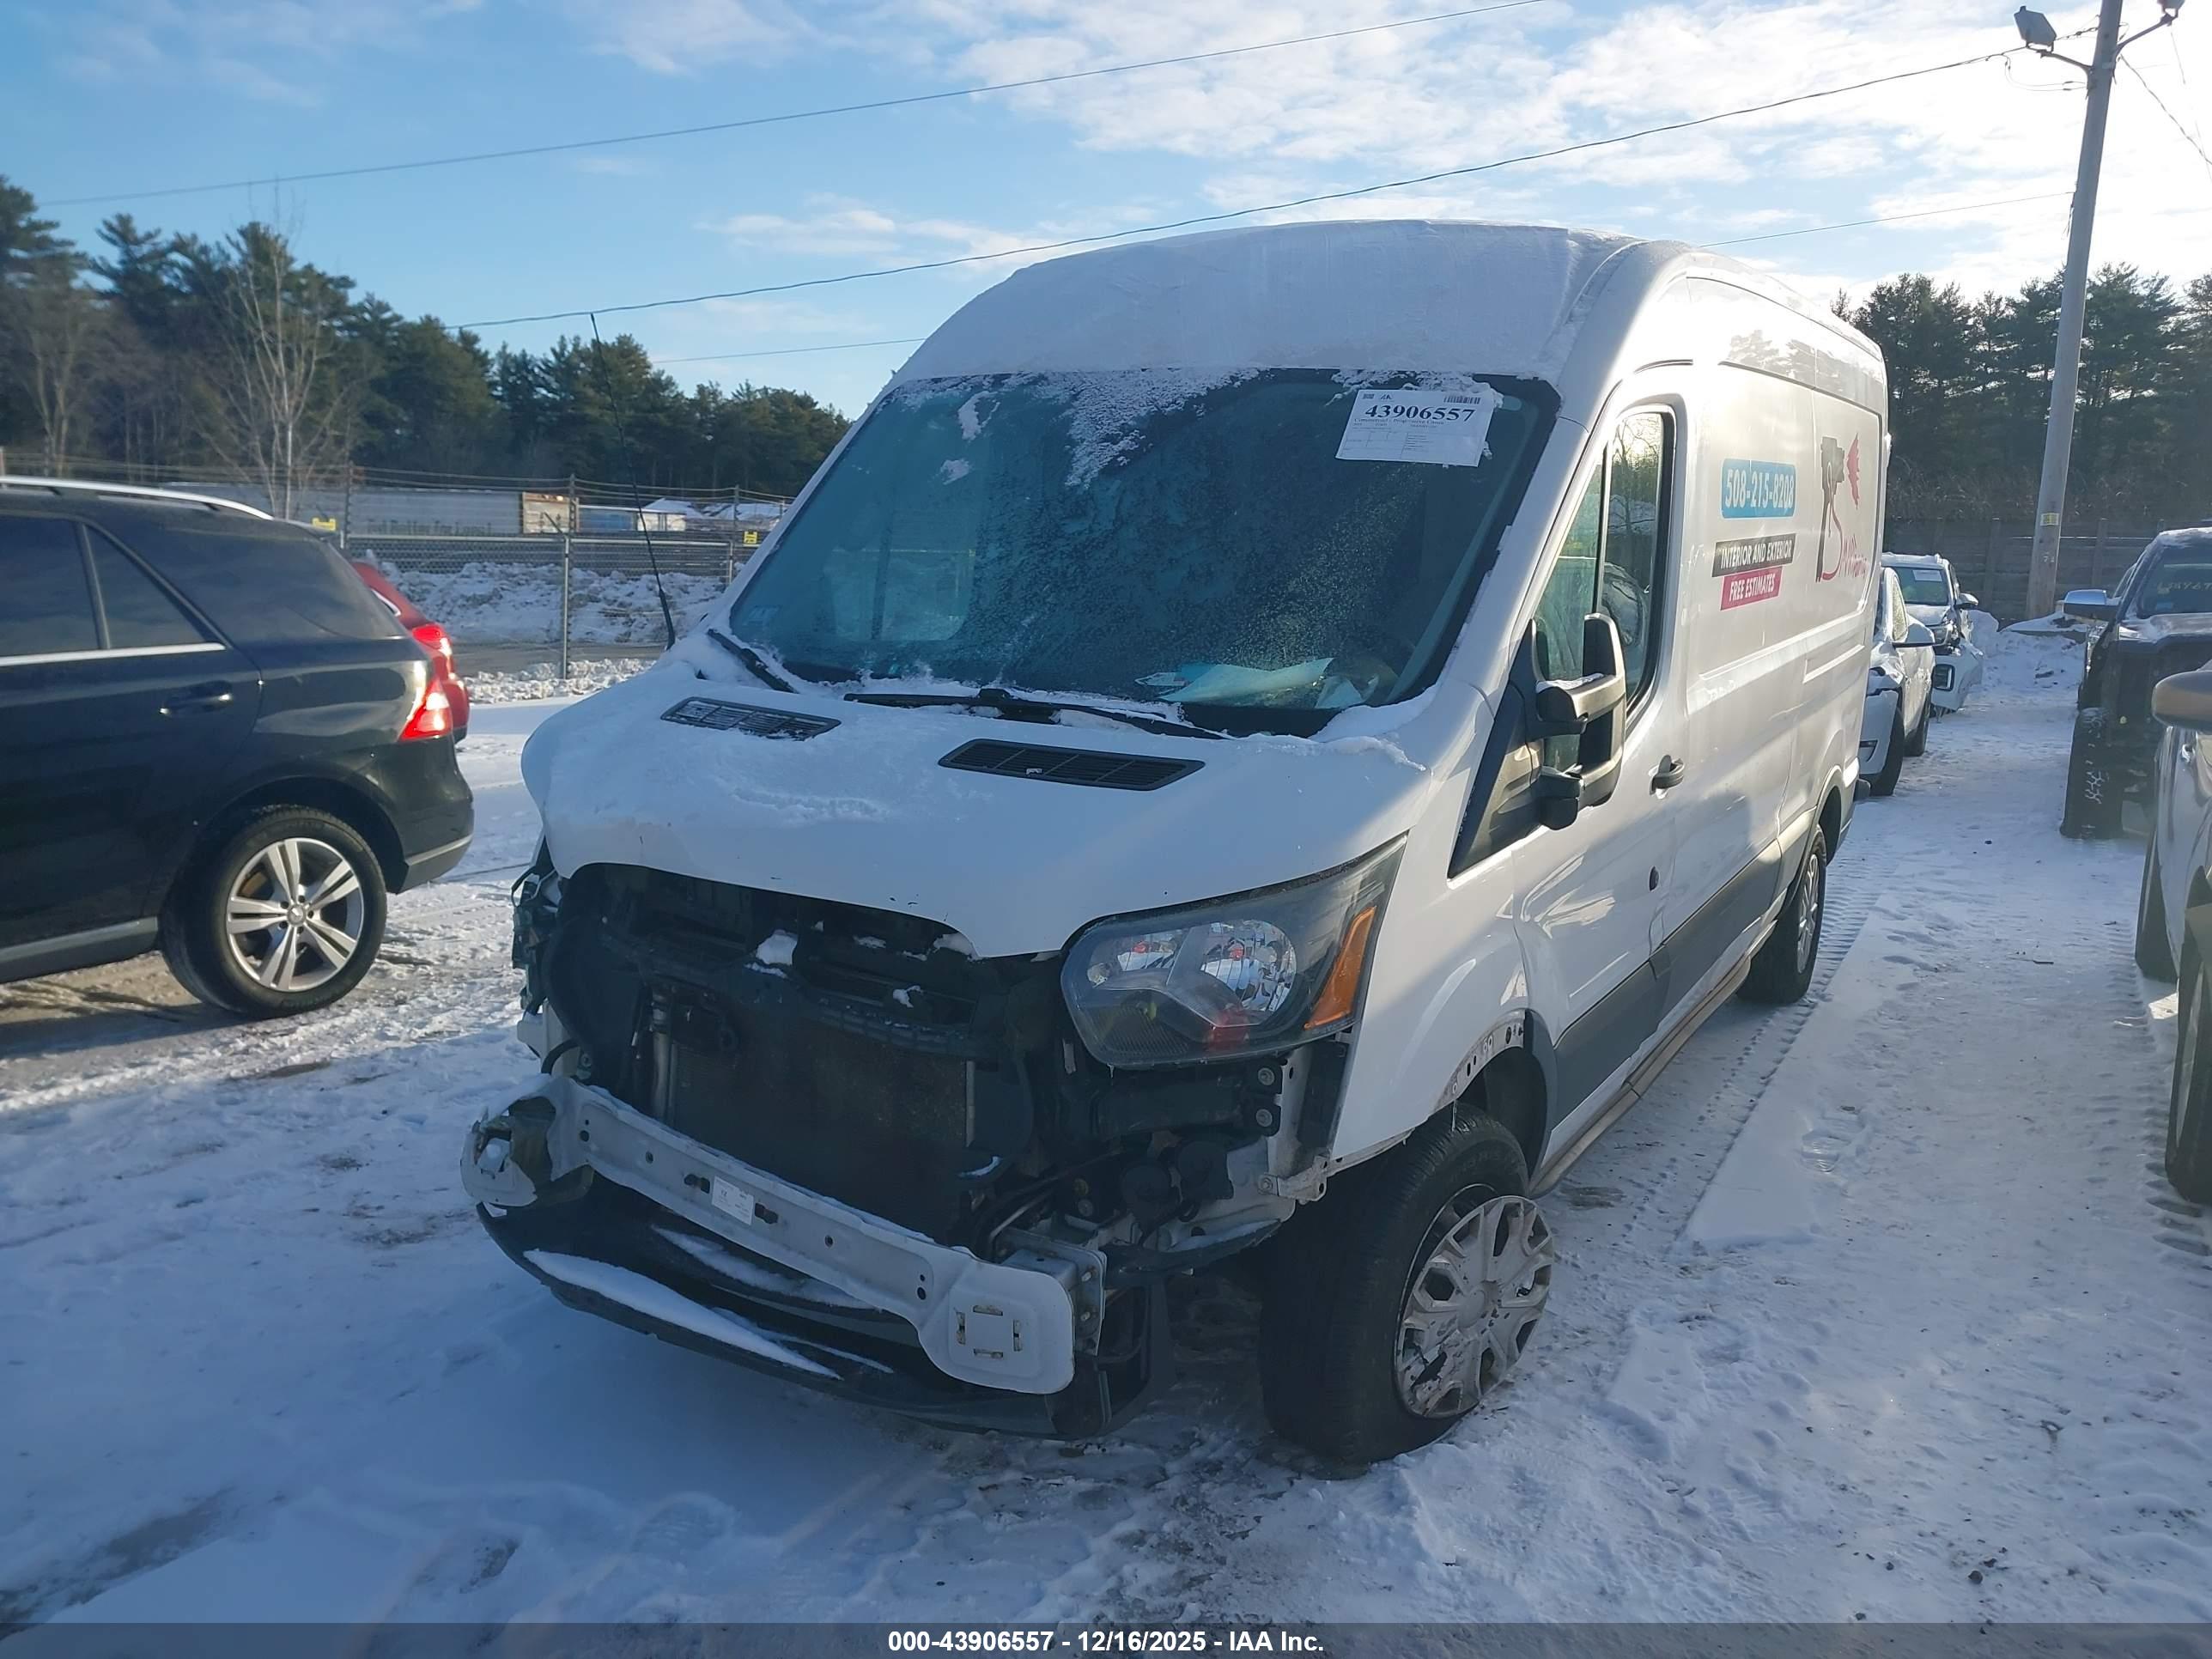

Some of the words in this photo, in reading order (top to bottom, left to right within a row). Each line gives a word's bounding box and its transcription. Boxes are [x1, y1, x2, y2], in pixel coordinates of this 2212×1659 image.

[1364, 404, 1476, 422] 43906557
[1724, 469, 1795, 508] 508-215-8208
[1721, 544, 1753, 568] INTERIOR
[1752, 543, 1767, 564] AND
[1766, 539, 1793, 562] EXTERIOR
[1729, 579, 1746, 602] FREE
[1744, 573, 1776, 599] ESTIMATES
